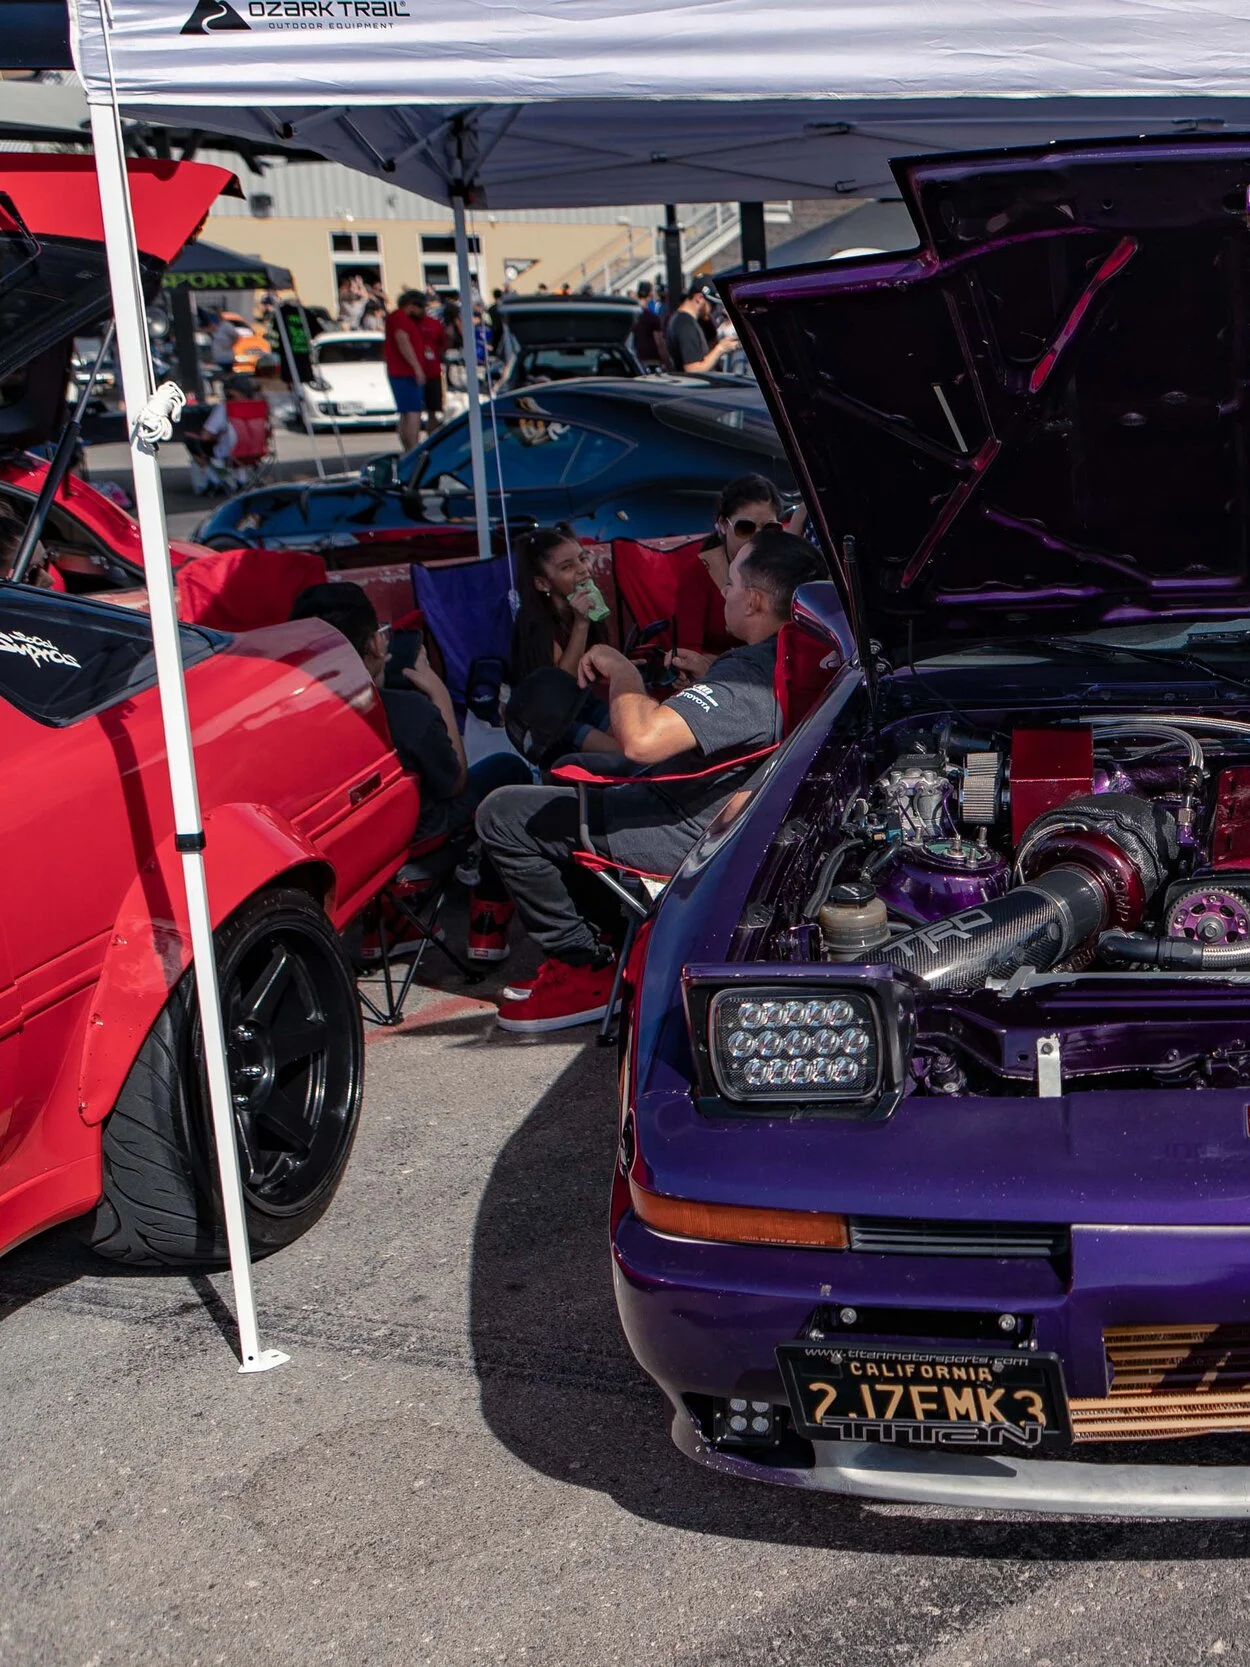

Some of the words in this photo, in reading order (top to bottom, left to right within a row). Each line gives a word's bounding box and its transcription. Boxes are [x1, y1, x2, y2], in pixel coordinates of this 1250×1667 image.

[268, 22, 323, 30] OUTDOOR
[328, 22, 394, 30] EQUIPMENT
[684, 692, 711, 713] TOYOTA
[882, 909, 993, 957] TRD
[804, 1348, 1029, 1367] www.titanmotorsports.com
[849, 1362, 993, 1382] CALIFORNIA
